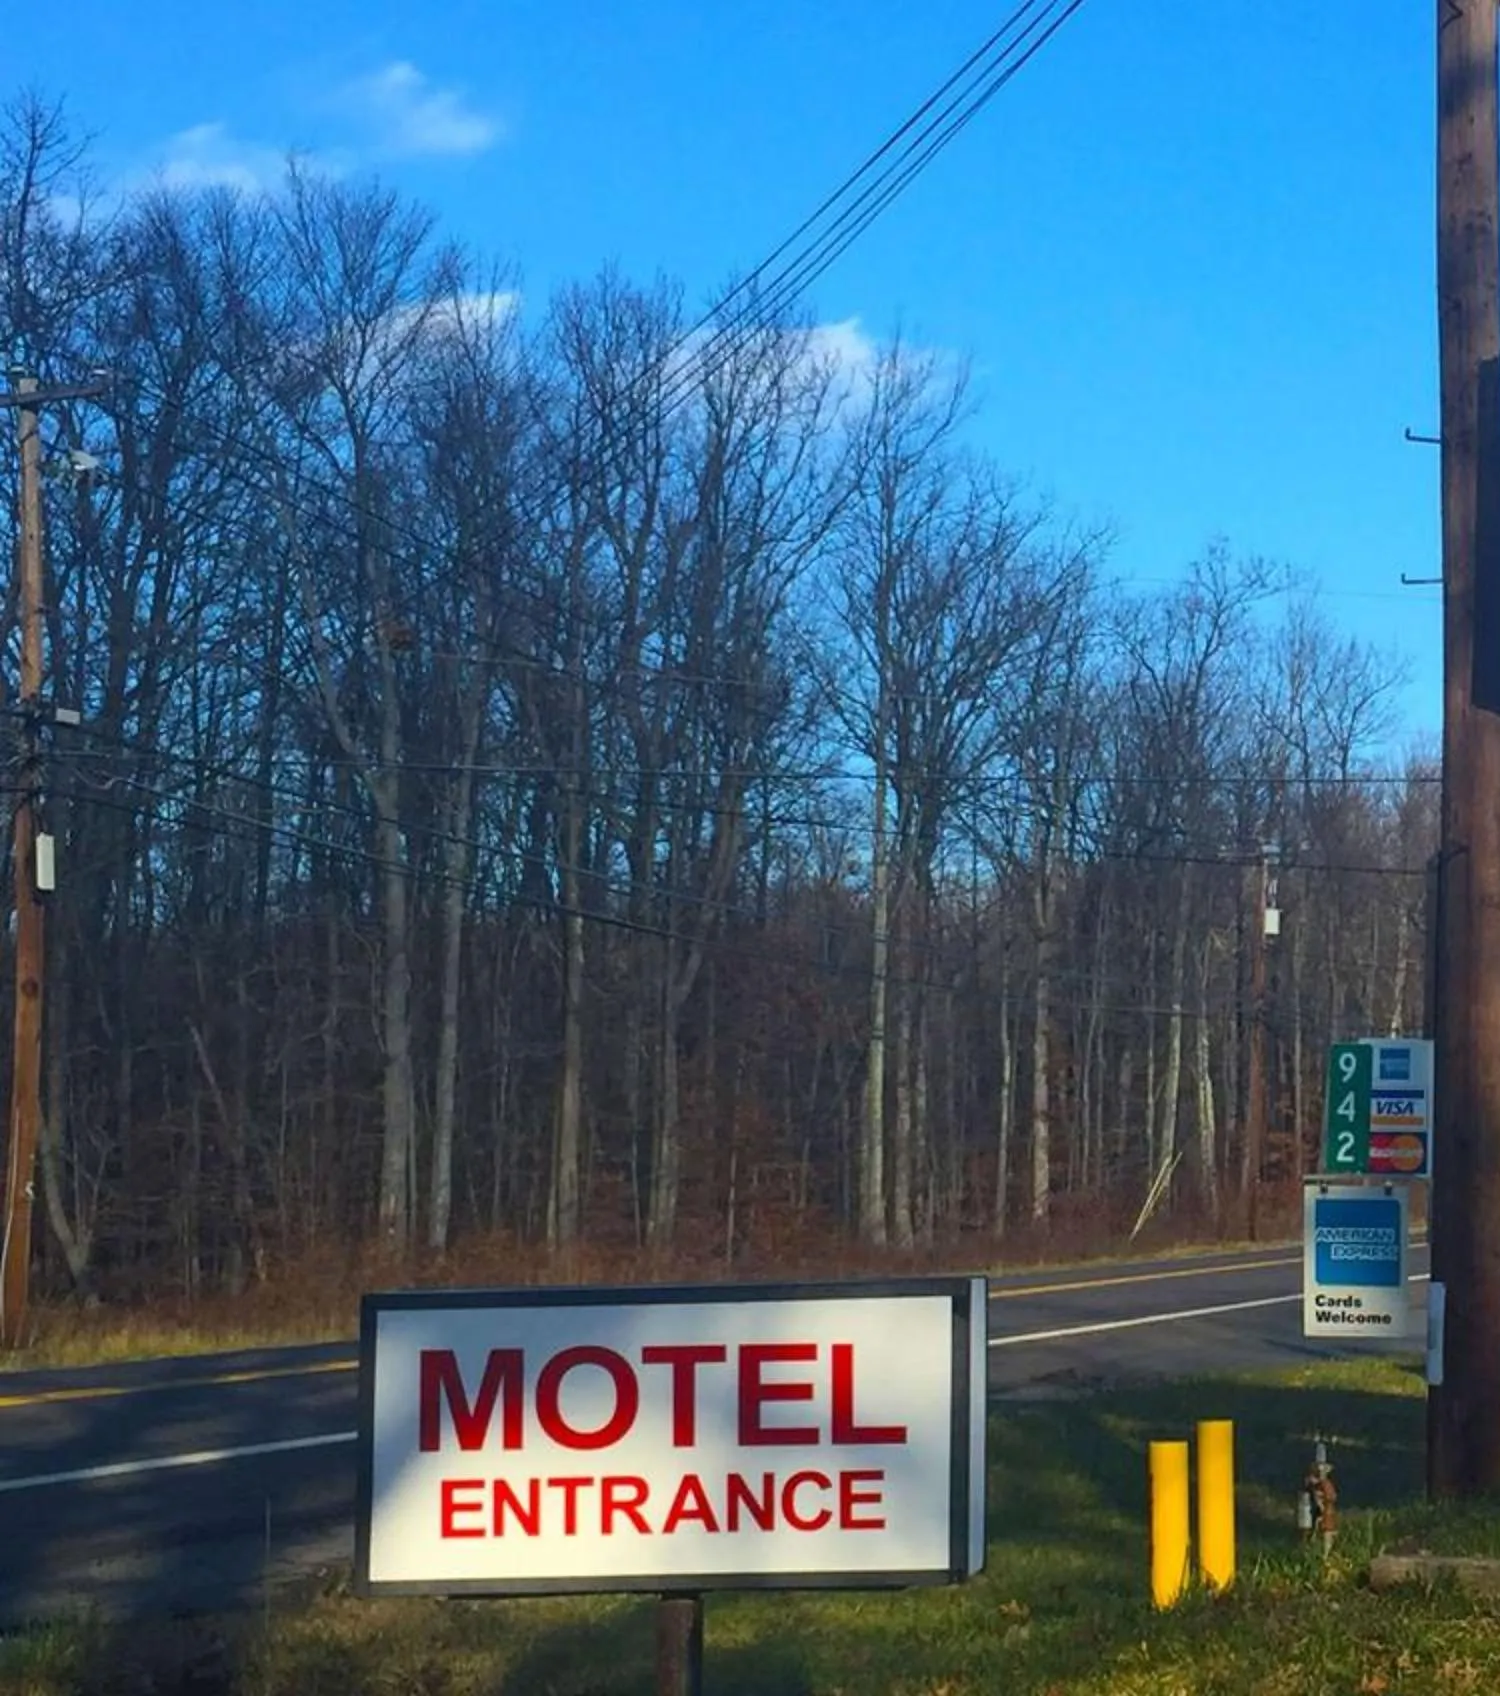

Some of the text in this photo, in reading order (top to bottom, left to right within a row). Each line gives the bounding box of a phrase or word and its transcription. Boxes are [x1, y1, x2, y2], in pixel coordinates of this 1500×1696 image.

[1376, 1101, 1414, 1115] VISA
[1314, 1227, 1395, 1243] AMERICAN
[1315, 1294, 1362, 1308] Cards
[1315, 1311, 1392, 1325] Welcome
[418, 1343, 908, 1452] MOTEL
[440, 1470, 886, 1539] ENTRANCE
